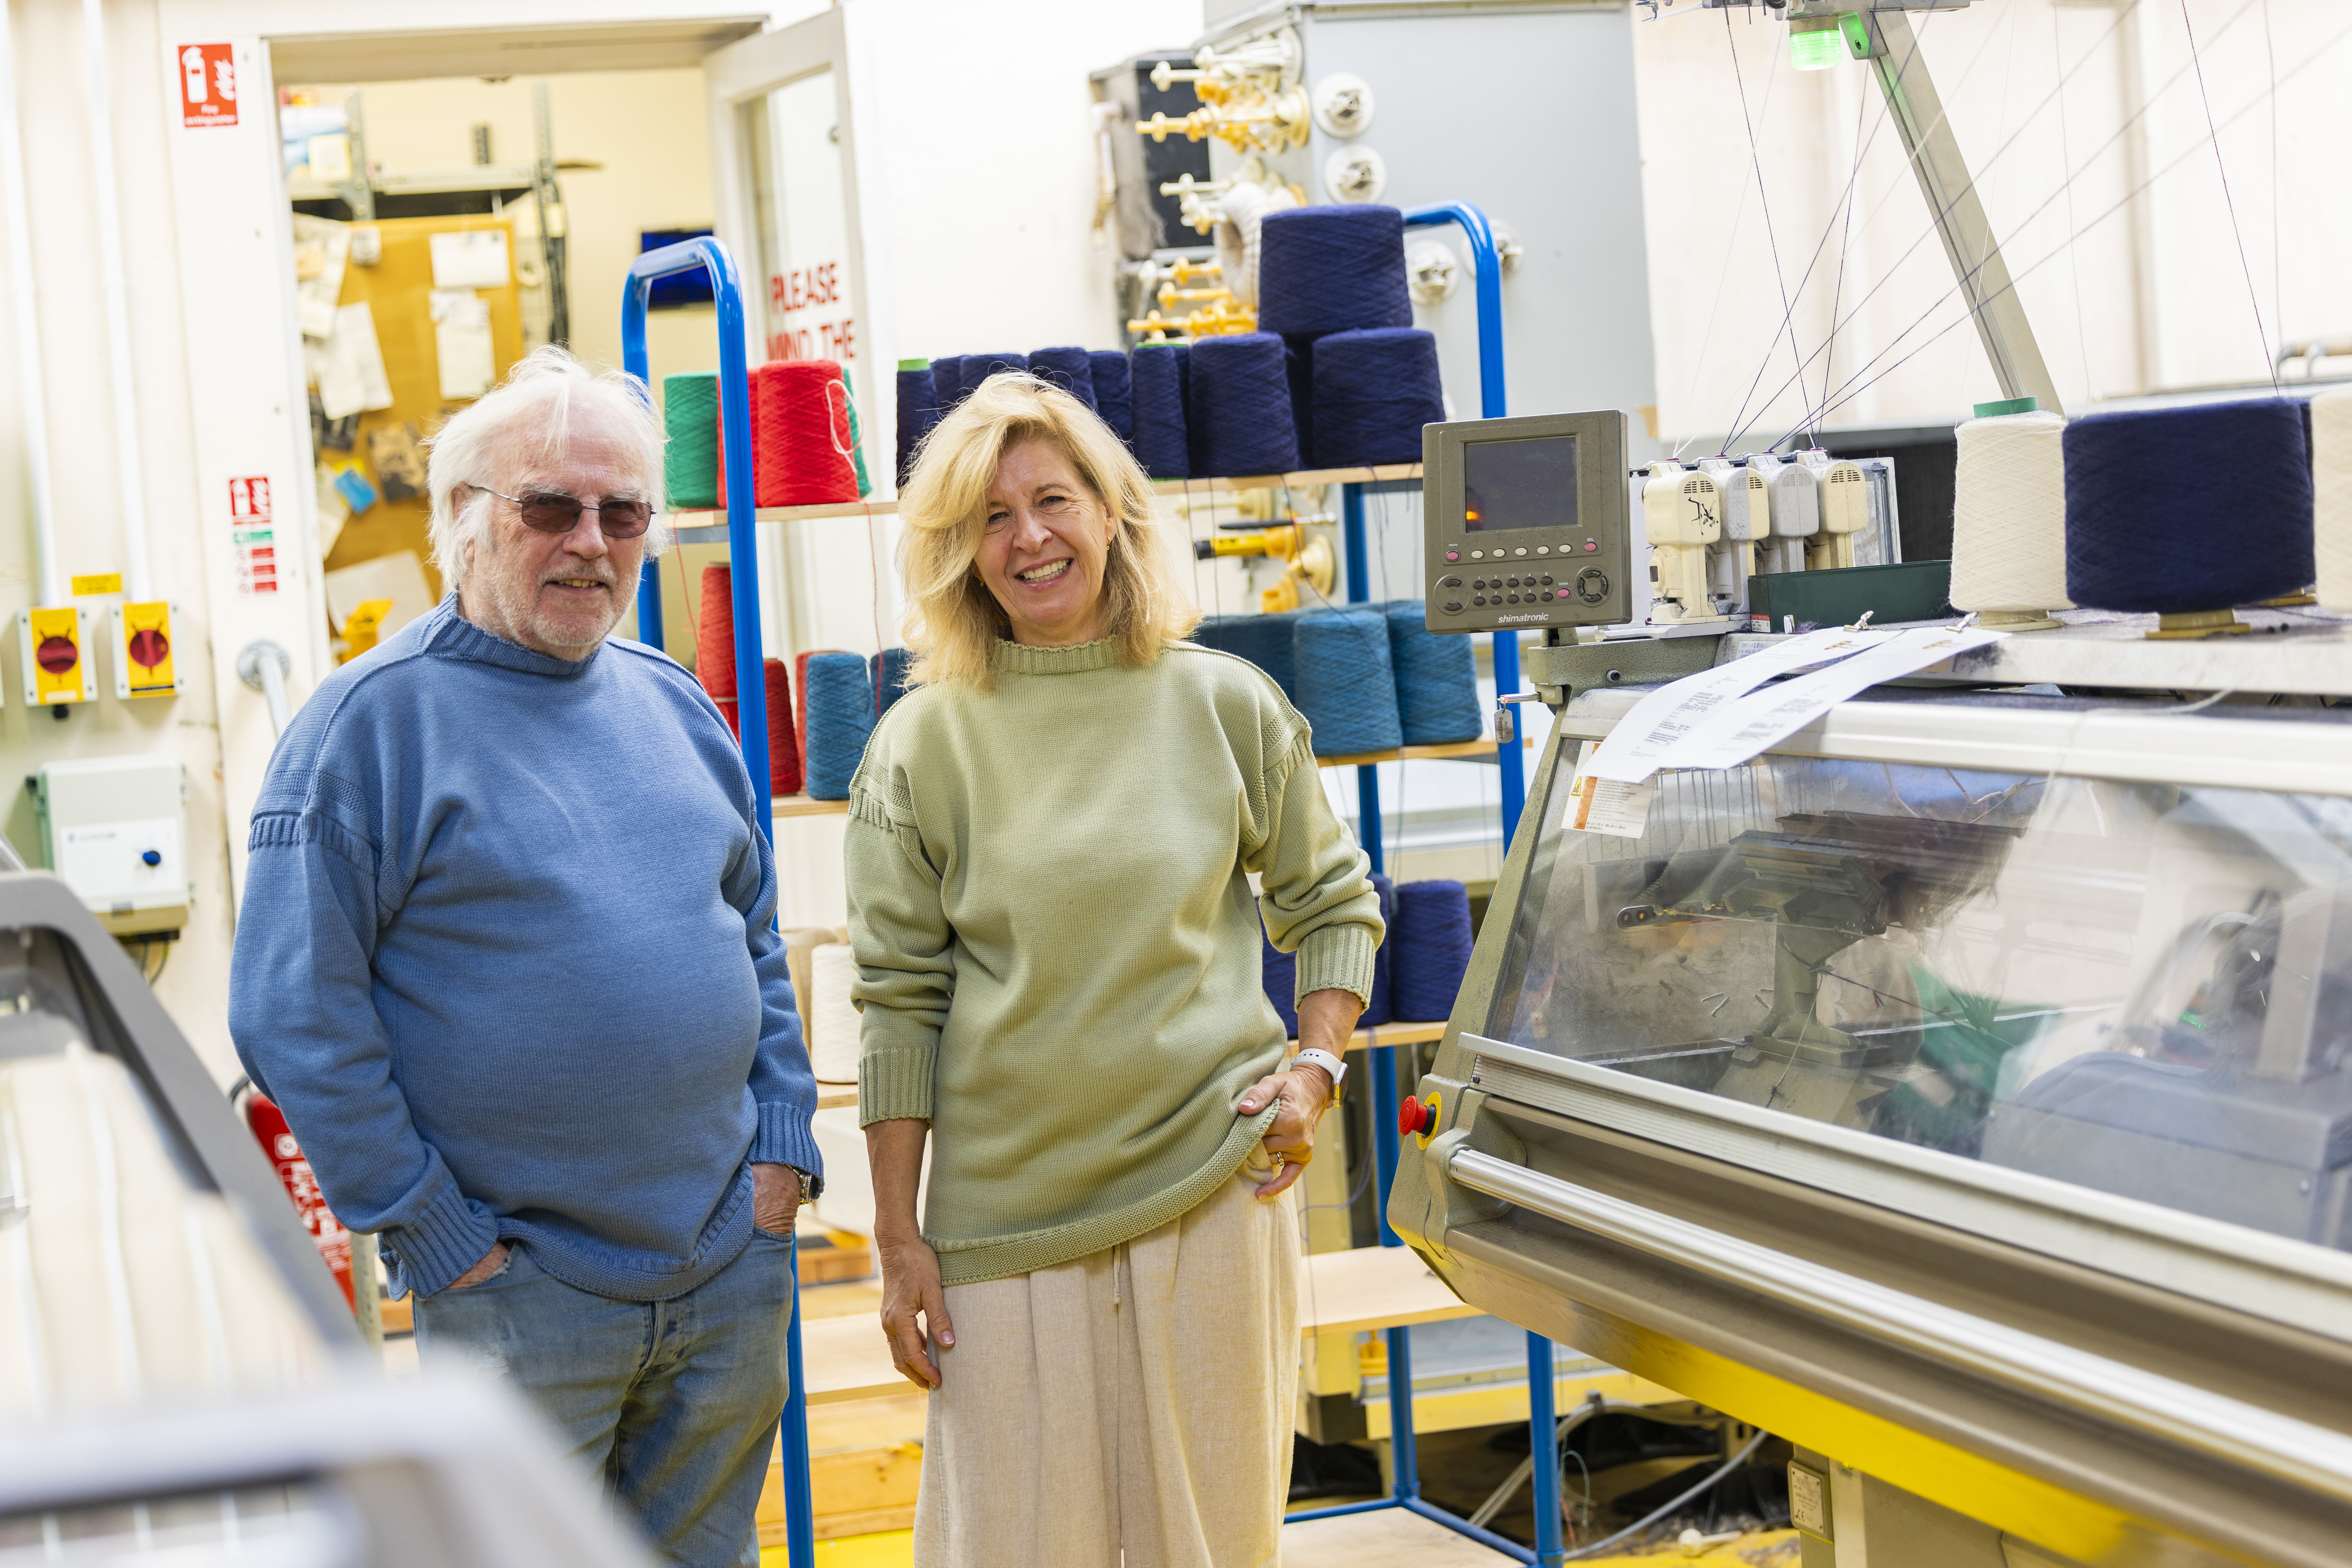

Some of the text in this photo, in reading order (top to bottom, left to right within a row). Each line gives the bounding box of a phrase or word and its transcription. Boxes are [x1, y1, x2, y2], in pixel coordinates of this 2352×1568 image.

[769, 261, 840, 315] PLEASE
[819, 319, 857, 360] THE
[1498, 612, 1549, 623] shimatronic
